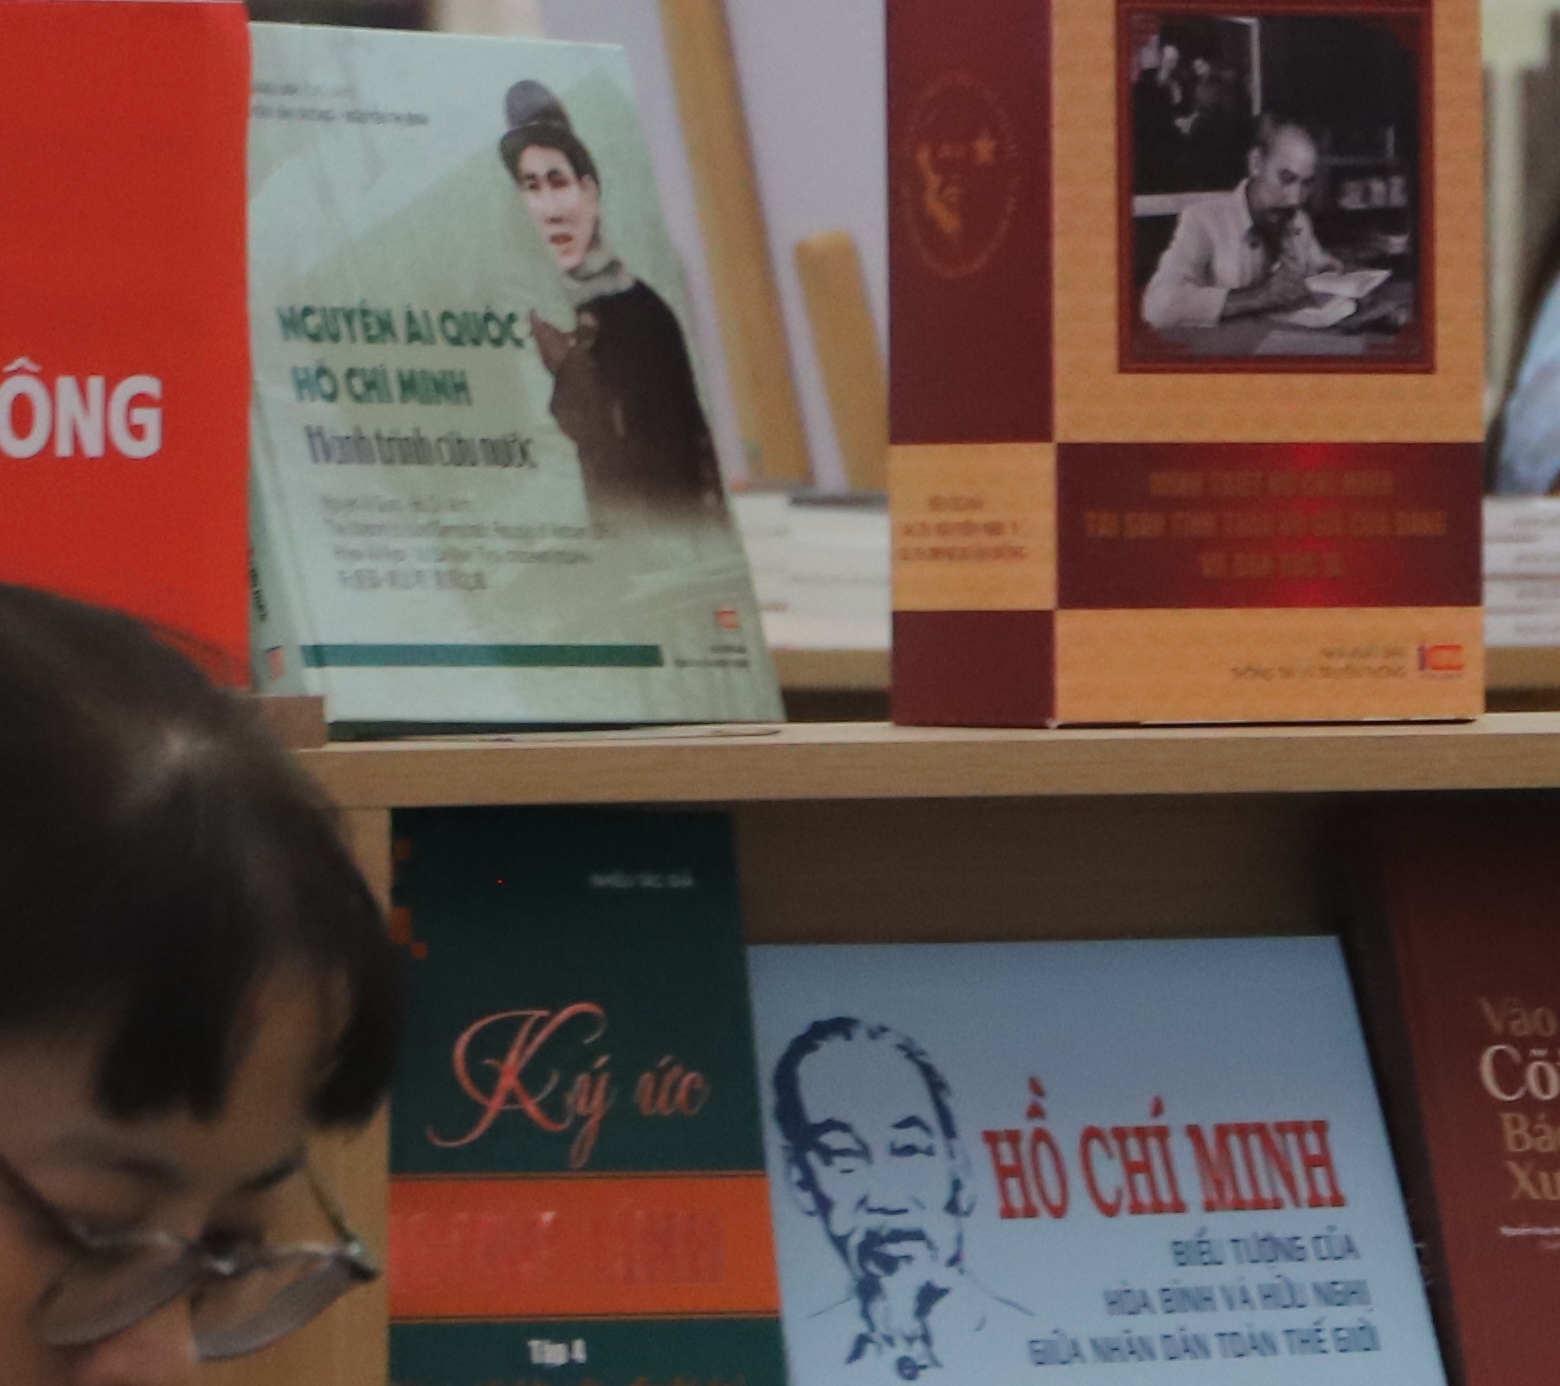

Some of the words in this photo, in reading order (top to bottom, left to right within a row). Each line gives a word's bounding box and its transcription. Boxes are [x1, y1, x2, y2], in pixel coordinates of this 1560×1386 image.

[1478, 993, 1558, 1041] Vào
[983, 1076, 1068, 1221] HỒ
[1078, 1096, 1188, 1216] CHÍ
[1184, 1117, 1346, 1212] MINH
